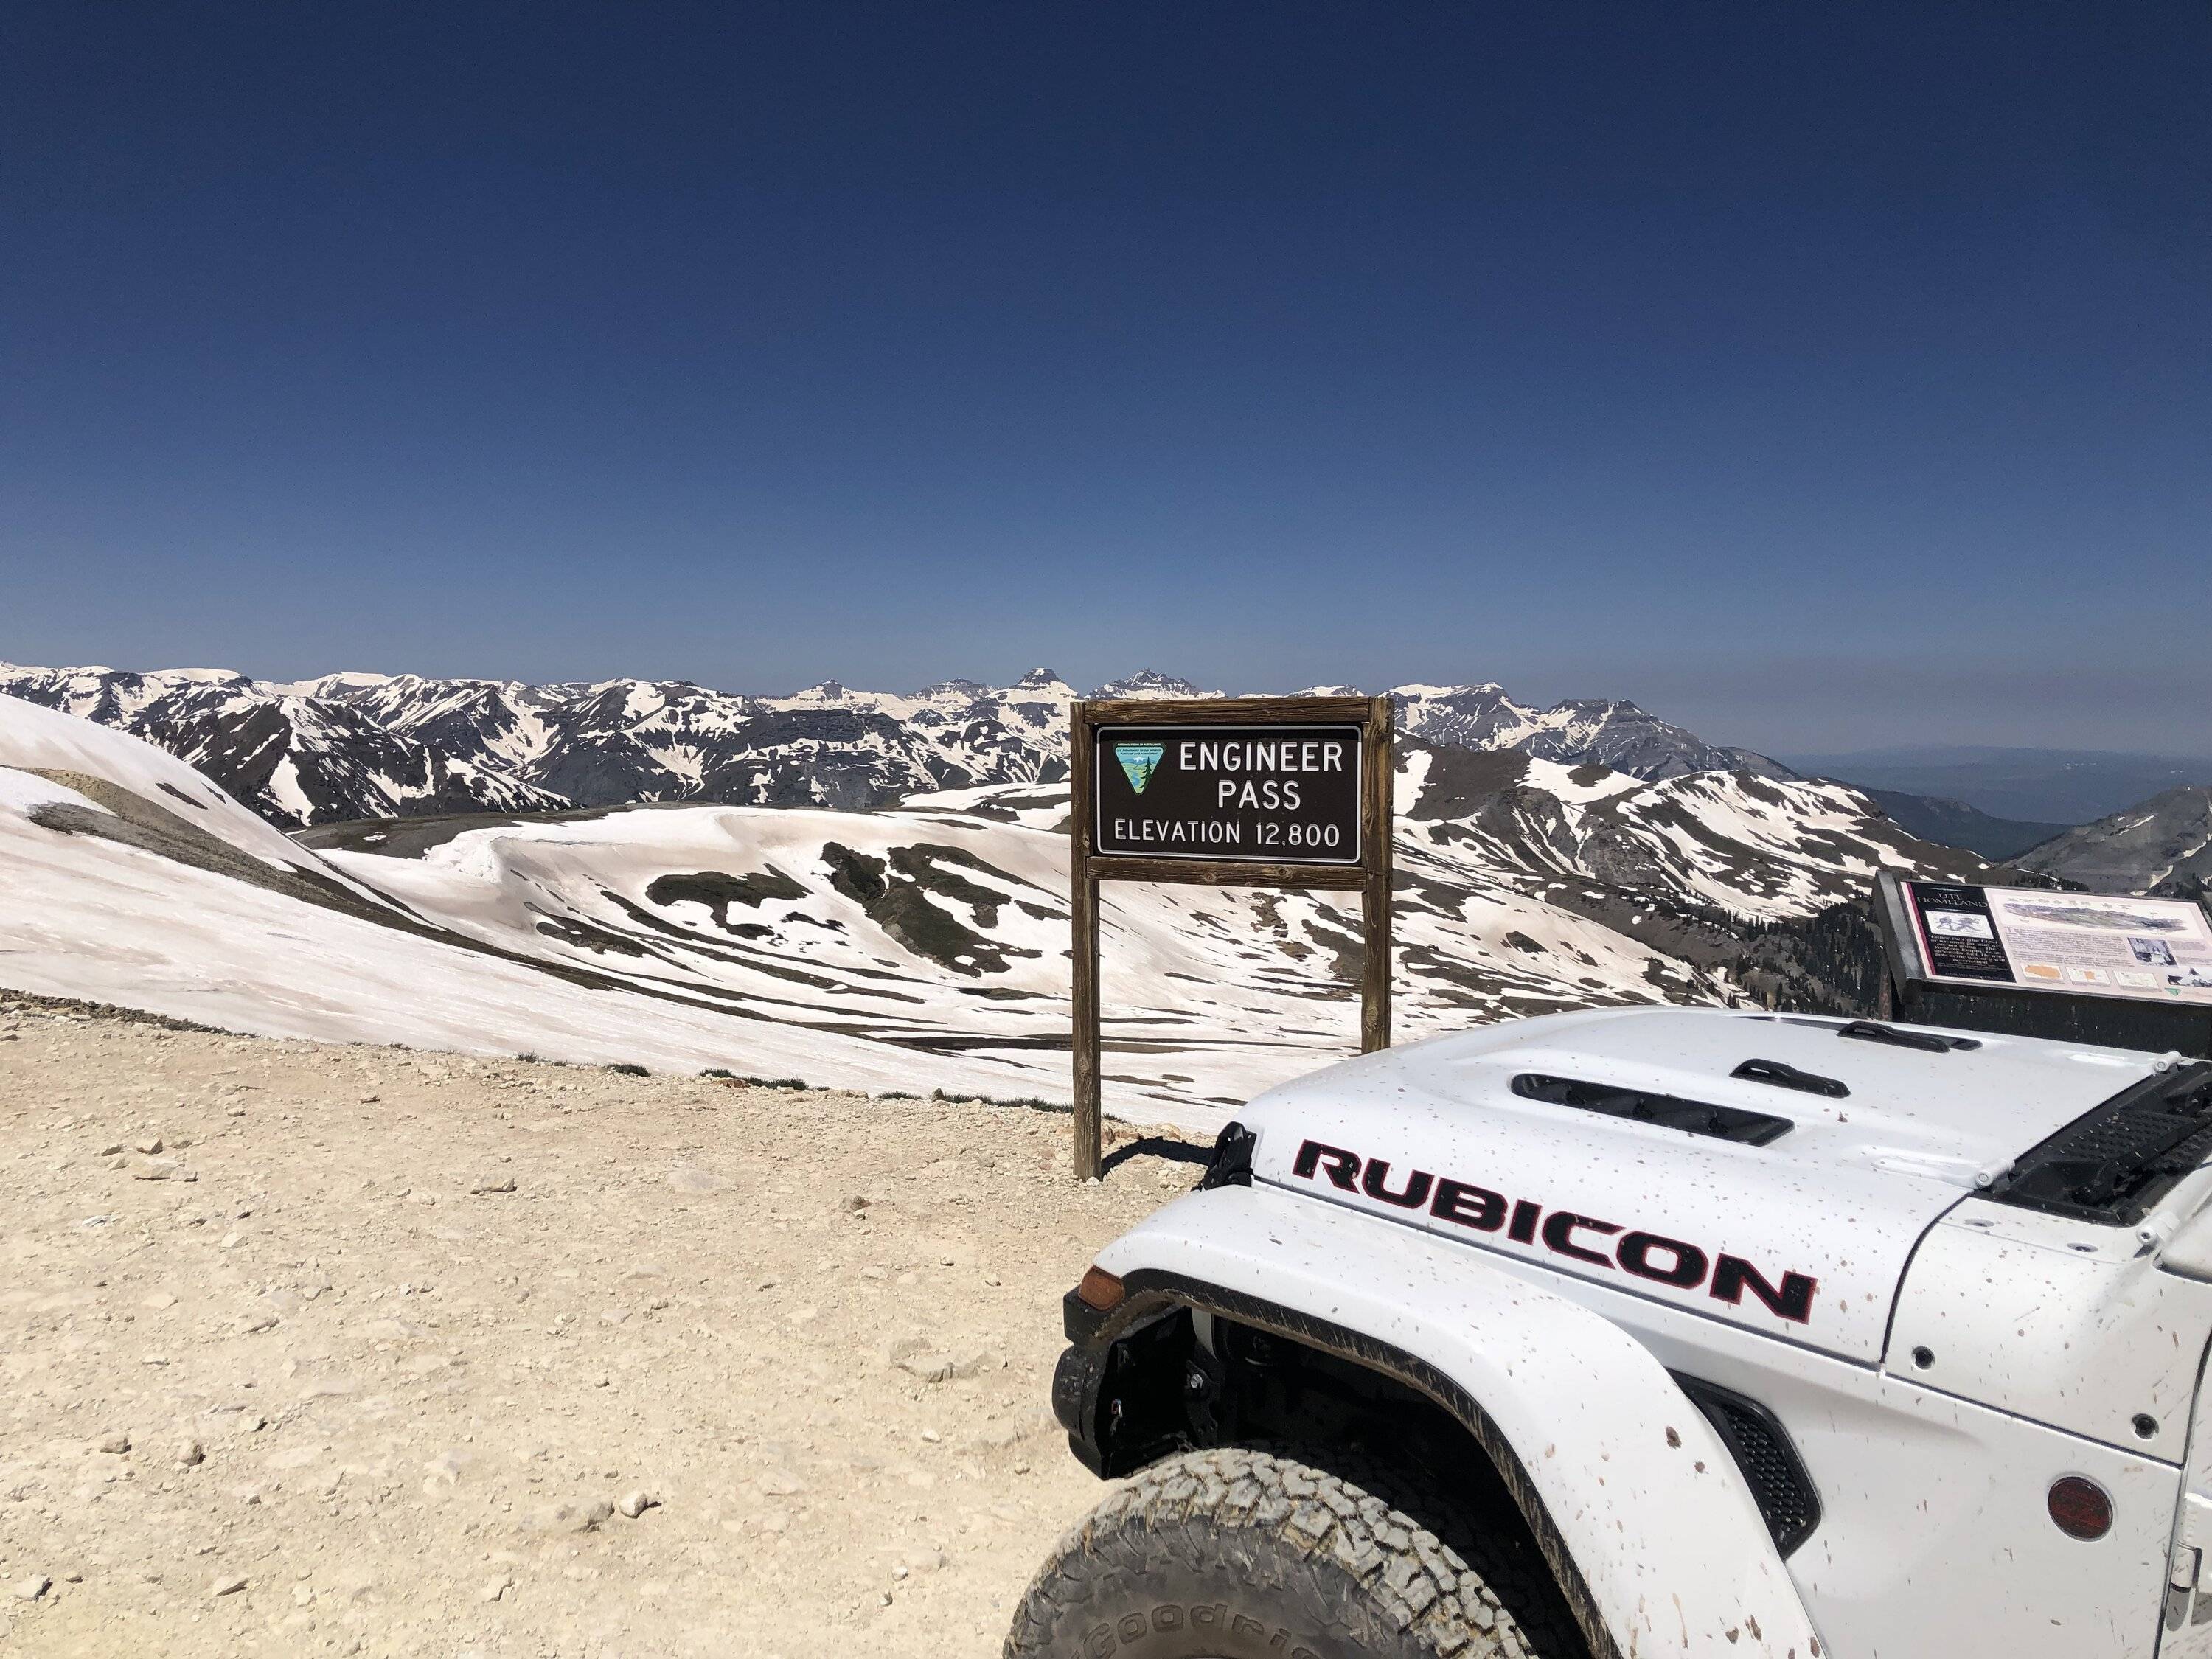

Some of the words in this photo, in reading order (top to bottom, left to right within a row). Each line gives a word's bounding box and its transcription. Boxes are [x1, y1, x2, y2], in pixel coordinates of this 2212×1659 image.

[1180, 741, 1343, 772] ENGINEER
[1218, 779, 1301, 810] PASS
[1115, 818, 1241, 844] ELEVATION
[1256, 822, 1340, 847] 12,800
[1917, 897, 1989, 908] HOMELAND
[1292, 1138, 1819, 1325] RUBICON
